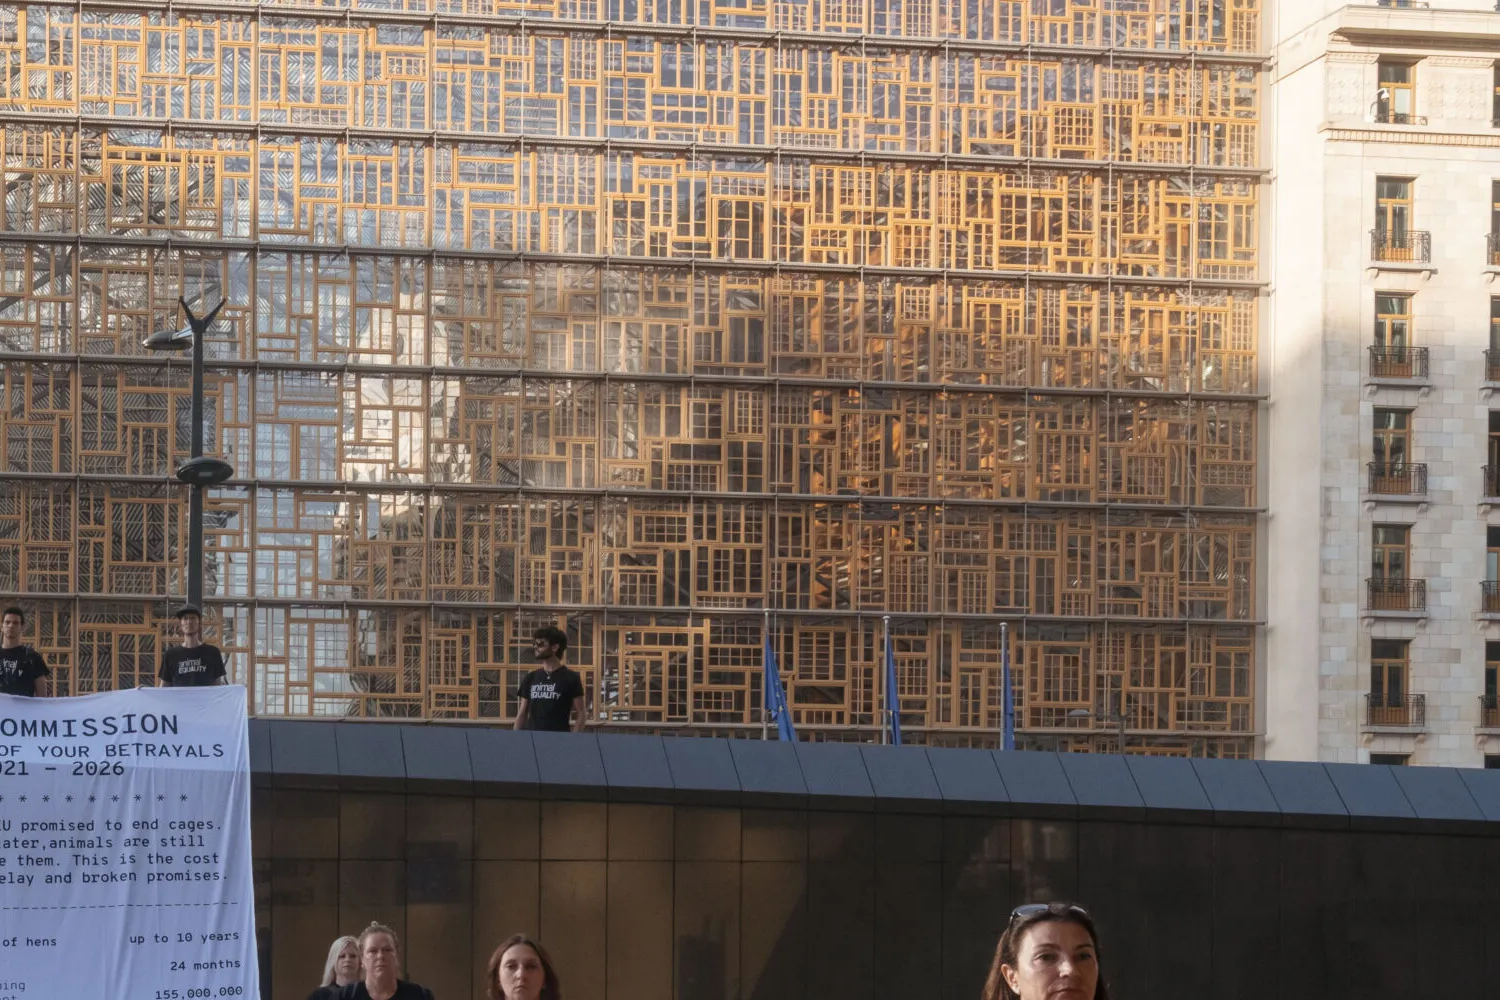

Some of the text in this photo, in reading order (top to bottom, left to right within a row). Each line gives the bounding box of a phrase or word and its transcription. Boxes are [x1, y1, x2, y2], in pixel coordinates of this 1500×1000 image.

[178, 658, 201, 667] animal
[179, 664, 206, 674] EQUALITY
[531, 682, 556, 692] animal
[37, 745, 90, 758] YOUR
[105, 742, 224, 758] BETRAYALS
[72, 760, 125, 777] 2026
[21, 818, 95, 834] promised
[105, 819, 123, 831] to
[132, 818, 159, 831] end
[168, 820, 221, 833] cages.
[123, 837, 150, 848] are
[160, 834, 205, 848] still
[16, 854, 60, 867] them.
[71, 853, 109, 867] This
[119, 853, 137, 865] is
[147, 852, 174, 865] the
[183, 852, 219, 865] cost
[44, 871, 72, 884] and
[82, 871, 137, 884] broken
[146, 869, 228, 885] promises.
[2, 936, 18, 947] of
[26, 936, 57, 947] hens
[129, 932, 240, 946] up to 10 years
[170, 959, 241, 971] 24 months
[155, 985, 243, 1000] 155,000,000
